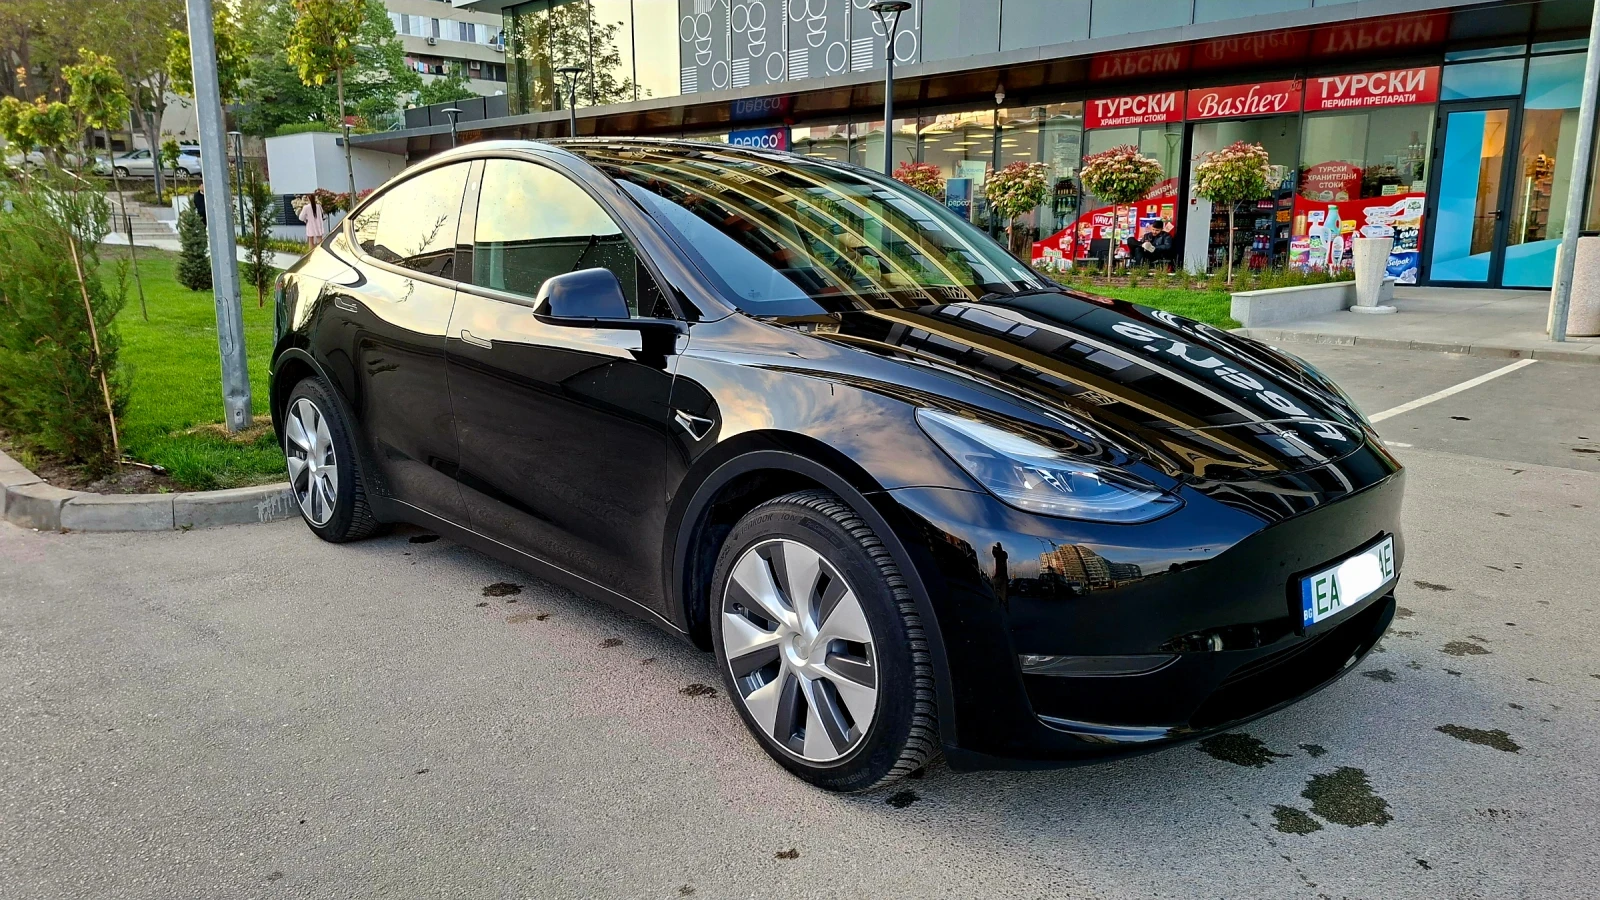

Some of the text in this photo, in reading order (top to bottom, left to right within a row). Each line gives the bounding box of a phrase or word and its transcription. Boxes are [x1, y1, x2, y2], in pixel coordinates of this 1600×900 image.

[1318, 70, 1426, 98] ТУРСКИ
[1095, 92, 1175, 118] ТУРСКИ
[1198, 85, 1289, 117] Bashev
[1322, 94, 1416, 108] ПЕРИЛНИ ПРЕПАРАТИ
[1100, 113, 1167, 126] ХРАНИТЕЛНИ СТОКИ
[1307, 173, 1357, 181] ХРАНИТЕЛНИ
[948, 200, 969, 208] pepco
[1315, 574, 1340, 616] EA
[1303, 607, 1313, 621] BG
